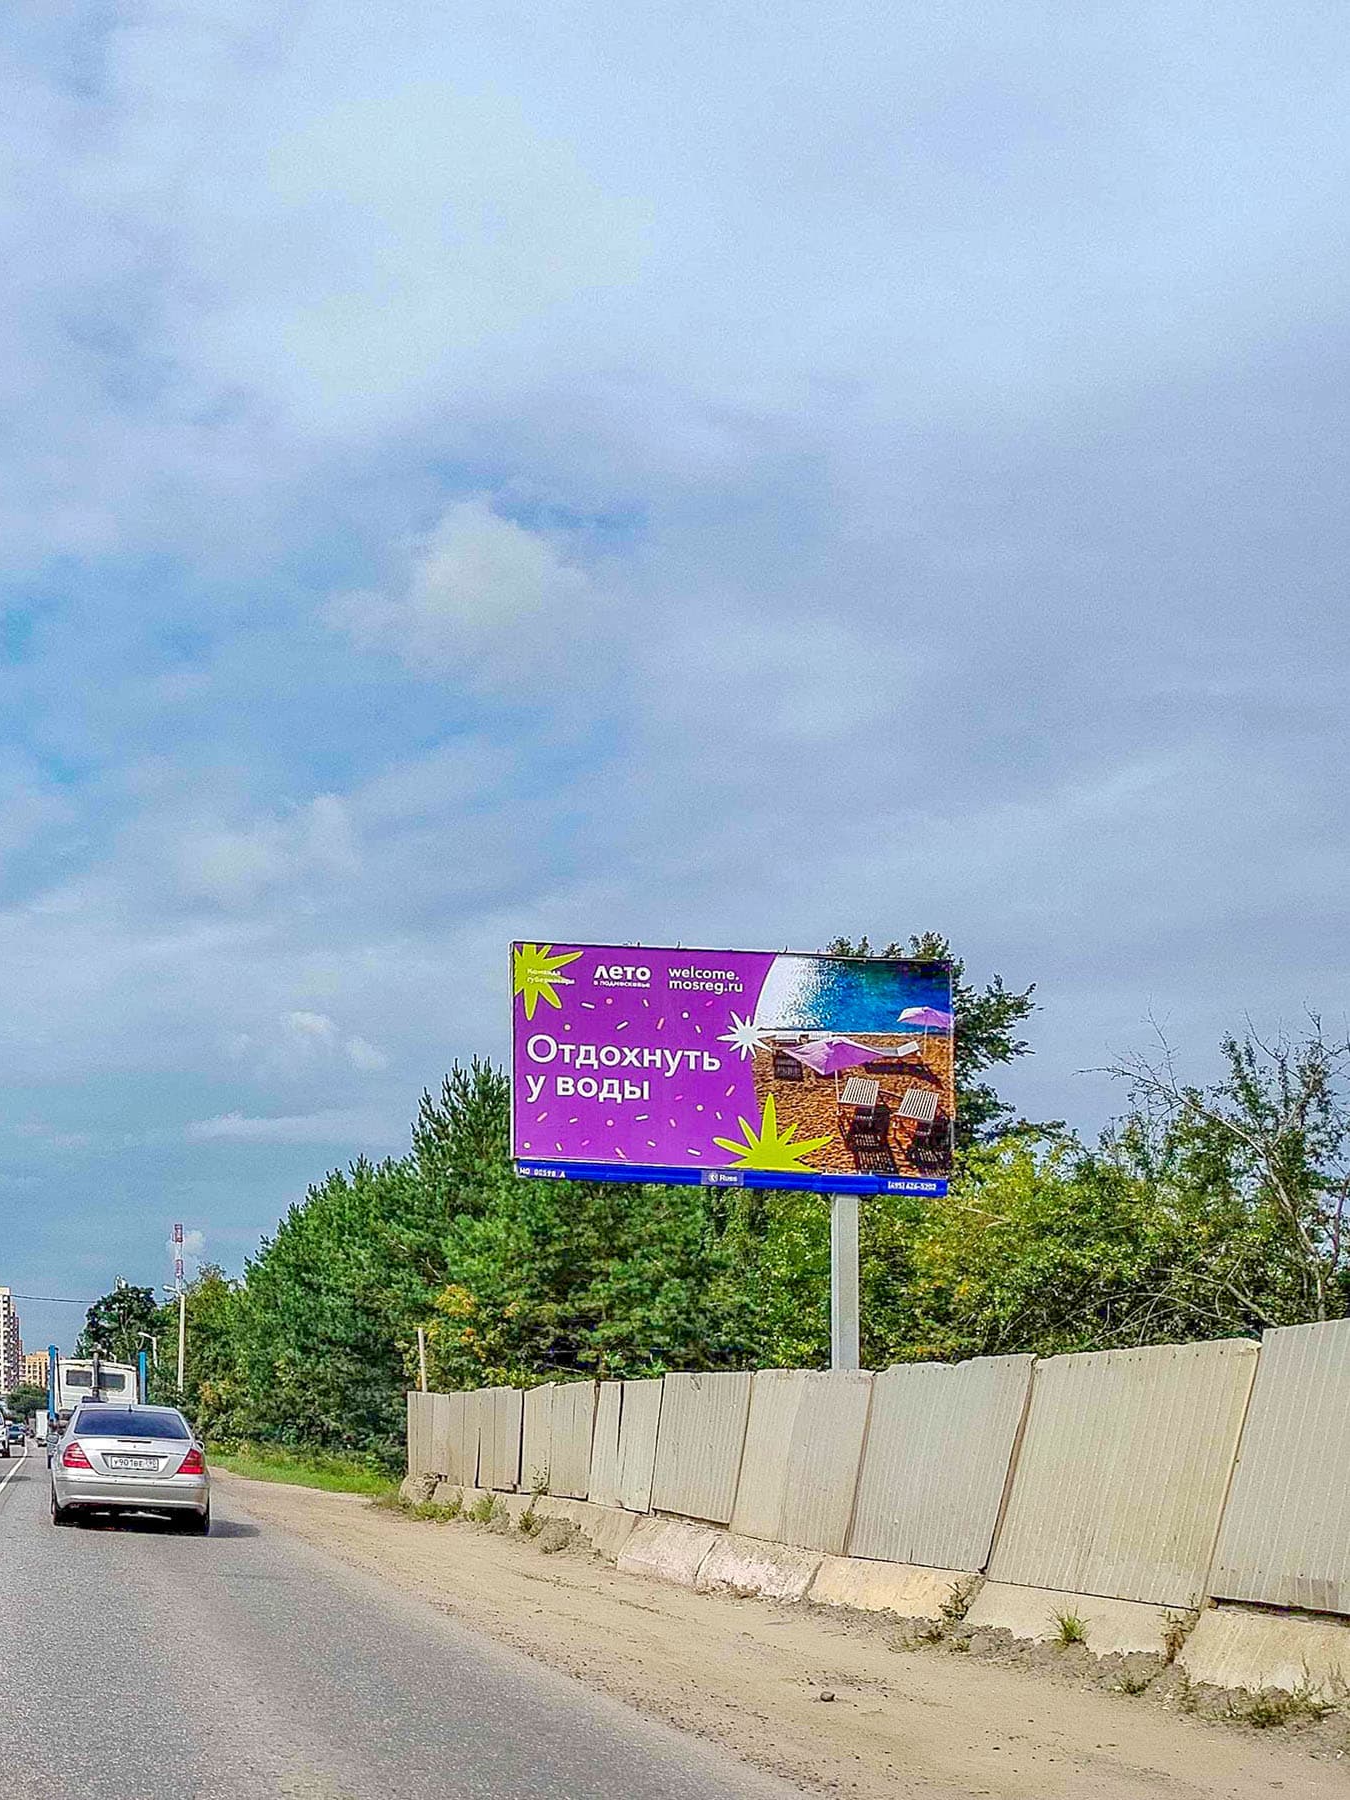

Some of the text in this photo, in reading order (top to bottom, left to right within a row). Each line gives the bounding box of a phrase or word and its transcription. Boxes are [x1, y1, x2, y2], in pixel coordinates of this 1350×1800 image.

[668, 965, 740, 981] welcome.
[669, 980, 744, 995] mosreg.ru
[526, 1034, 722, 1078] Отдохнуть
[525, 1074, 651, 1104] у воды
